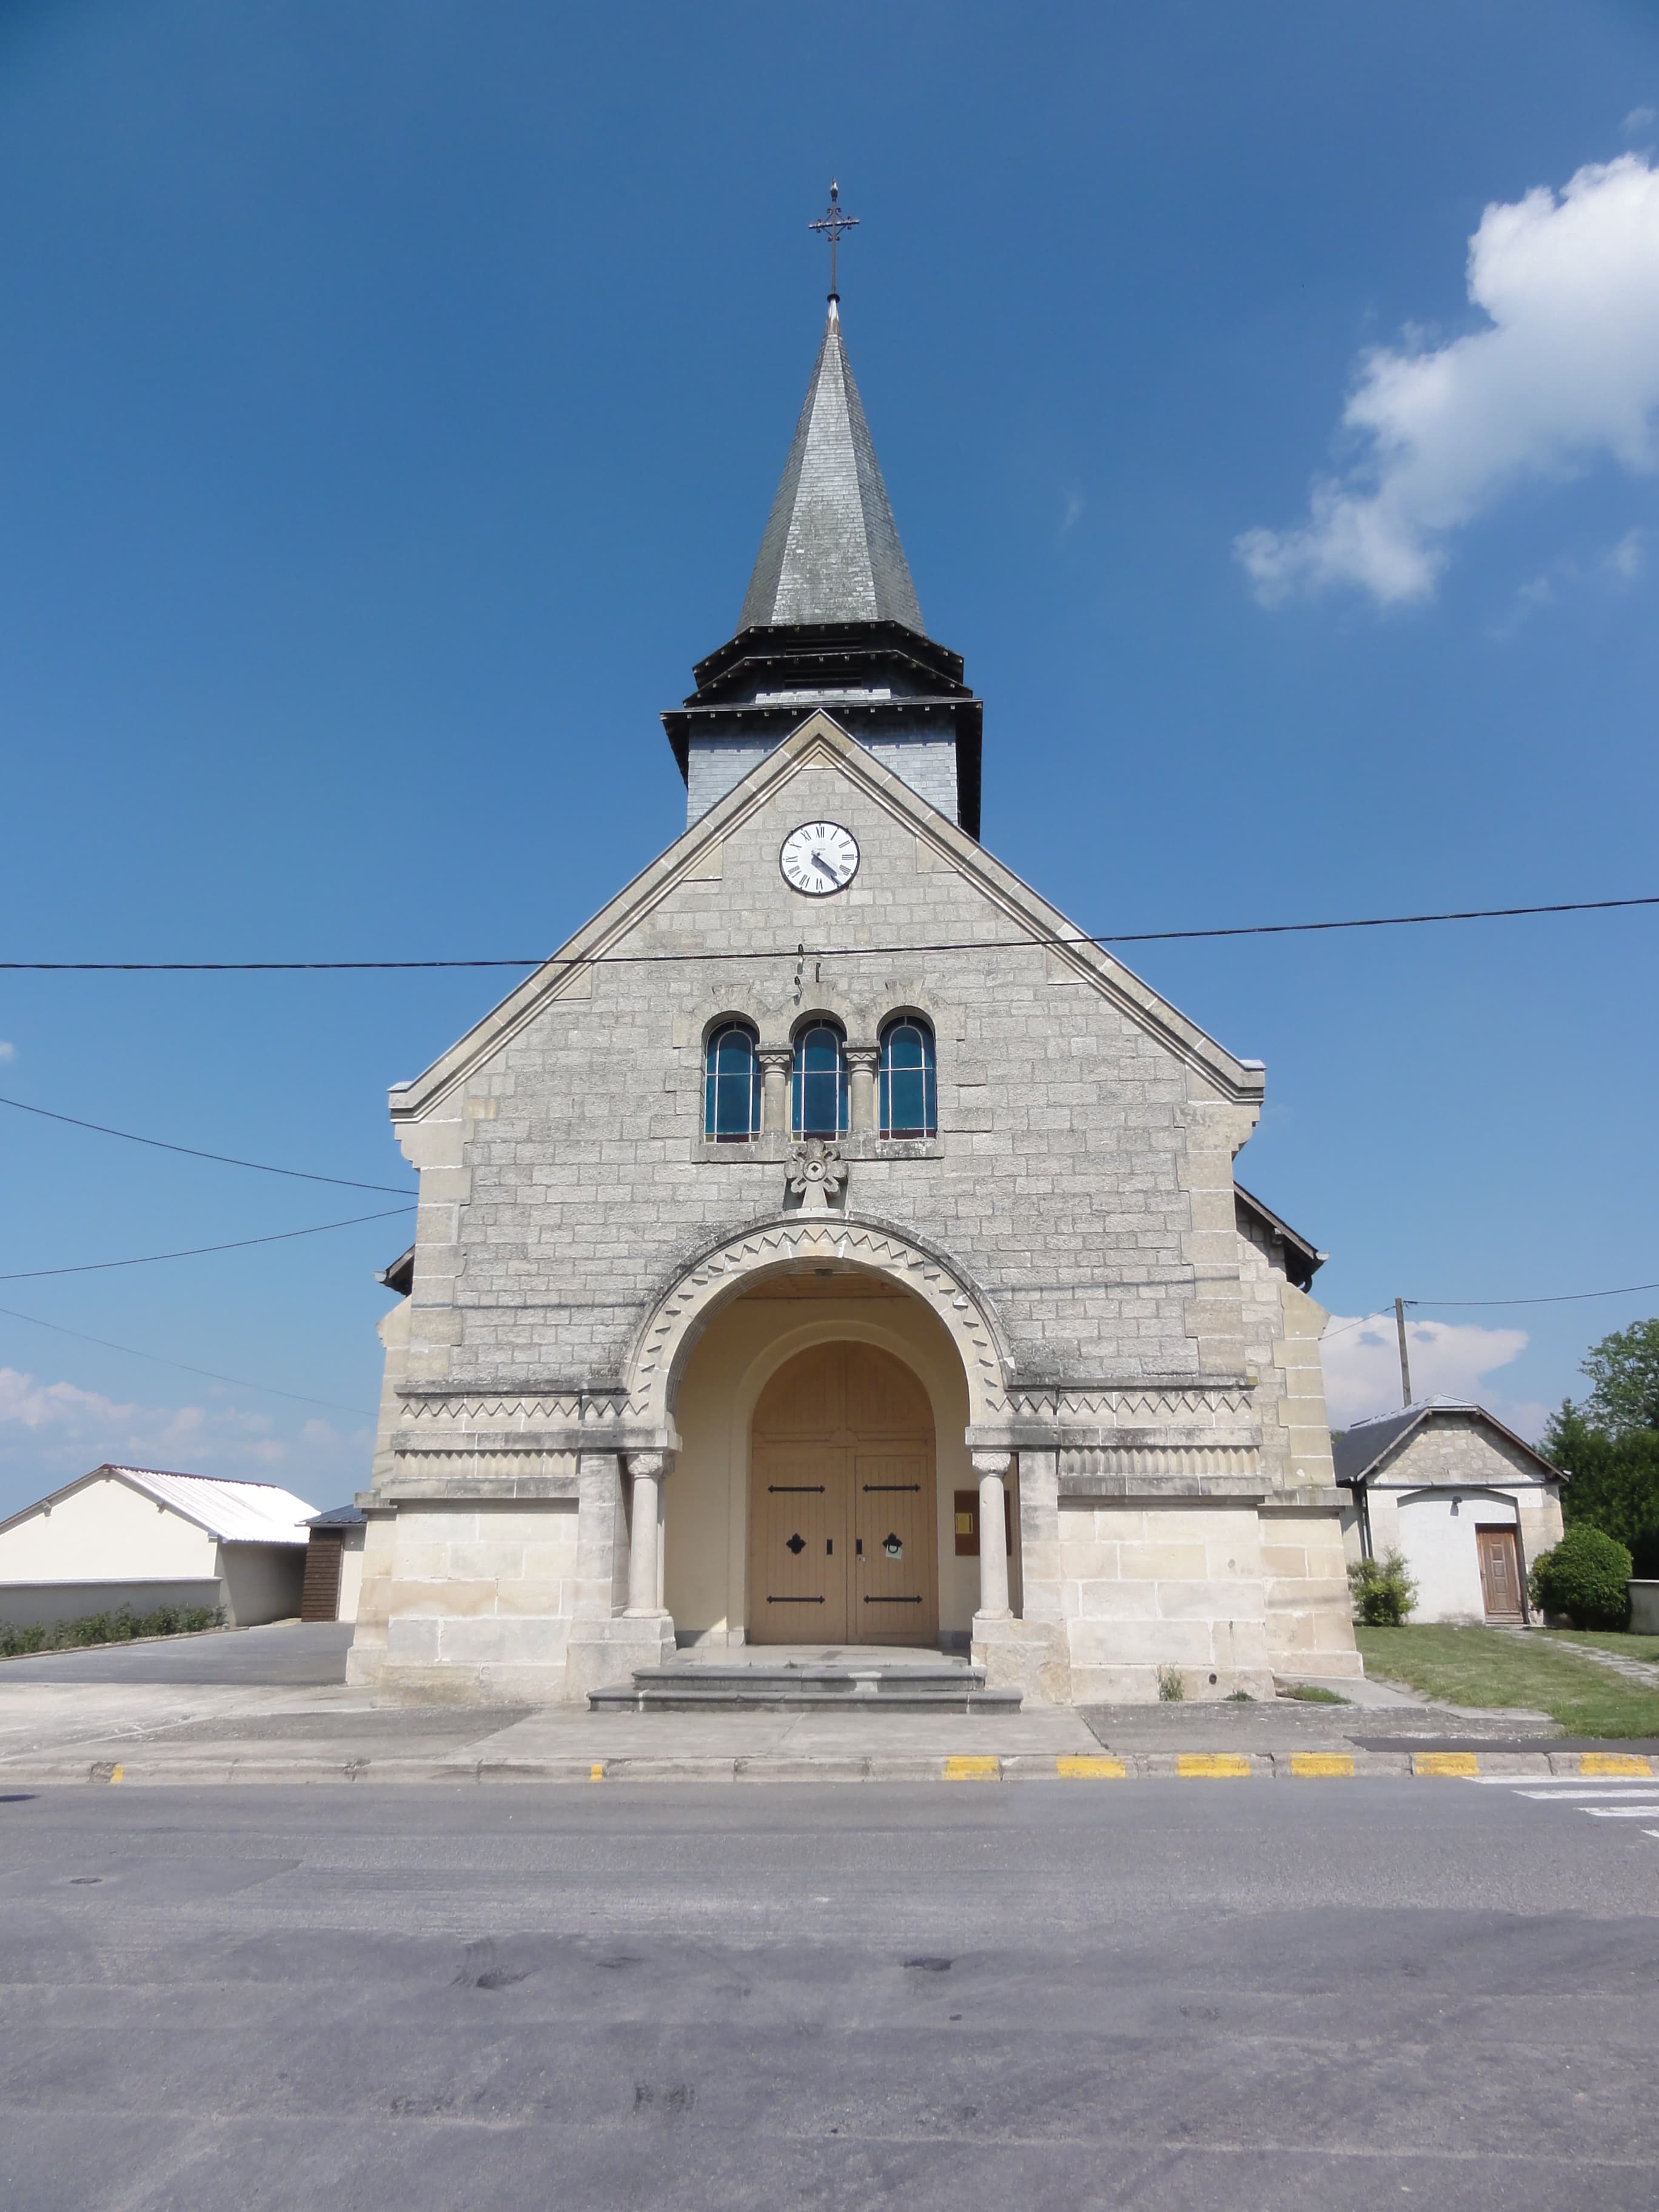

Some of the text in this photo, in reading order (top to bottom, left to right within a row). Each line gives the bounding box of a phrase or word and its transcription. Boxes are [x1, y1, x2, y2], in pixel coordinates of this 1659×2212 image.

[800, 830, 812, 843] XI
[816, 826, 825, 839] XII
[830, 830, 838, 841] I
[838, 840, 851, 849] II
[799, 874, 811, 888] VII
[816, 877, 823, 890] VI
